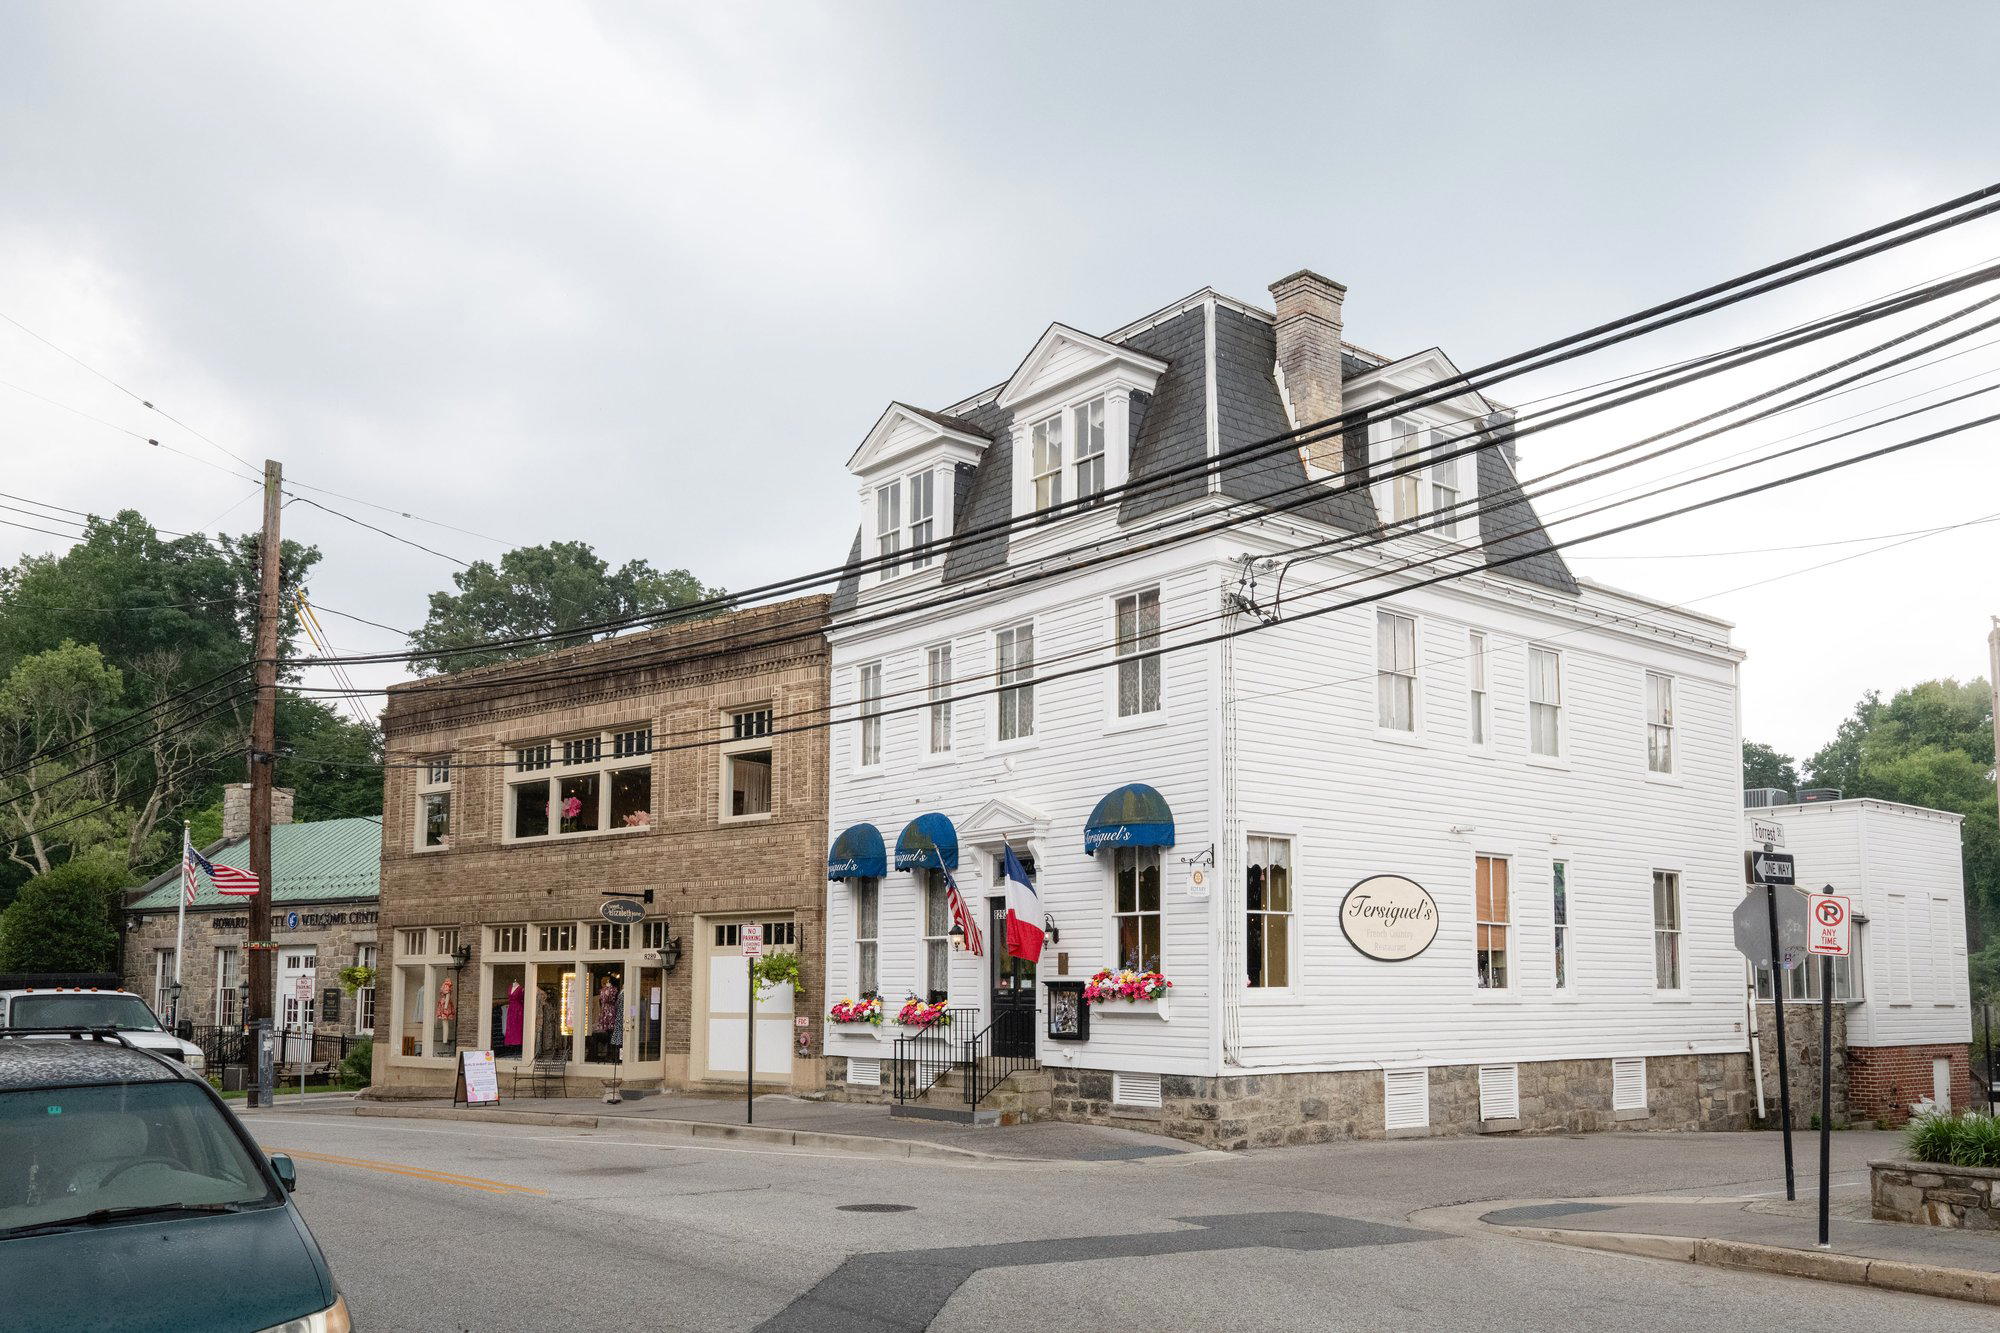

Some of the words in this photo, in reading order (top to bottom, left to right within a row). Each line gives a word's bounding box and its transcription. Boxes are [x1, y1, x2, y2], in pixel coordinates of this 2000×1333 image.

[1754, 822, 1776, 841] Forrest
[1764, 861, 1777, 875] ONE
[1777, 862, 1790, 876] WAY
[1348, 895, 1432, 928] Tersiguel's
[212, 917, 248, 929] HOWARD
[301, 912, 347, 927] WELCOME
[1366, 928, 1388, 939] French
[1389, 929, 1414, 940] Country
[1822, 928, 1837, 936] ANY
[1821, 936, 1837, 945] TIME
[797, 1018, 807, 1026] FDC
